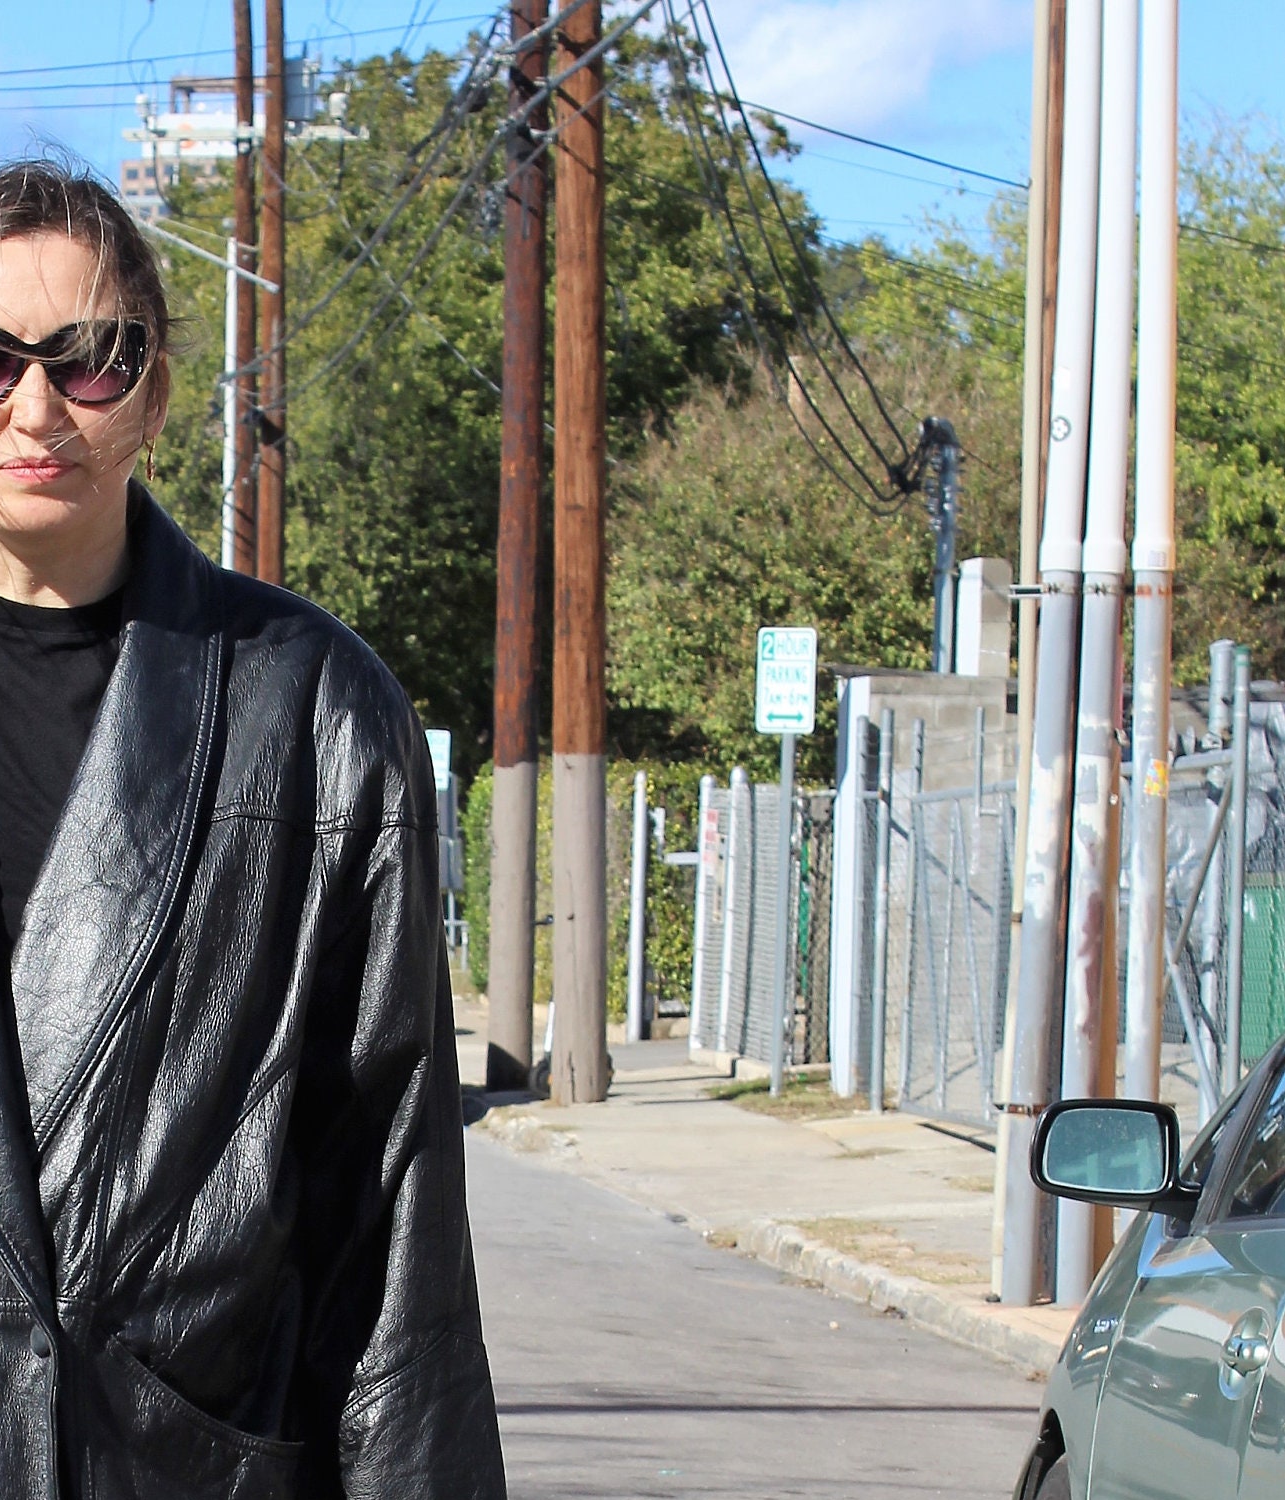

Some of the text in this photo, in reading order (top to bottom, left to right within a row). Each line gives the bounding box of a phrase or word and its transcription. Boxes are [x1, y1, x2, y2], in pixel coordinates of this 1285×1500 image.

[763, 633, 810, 659] 2 HOUR
[766, 665, 808, 685] PARKING
